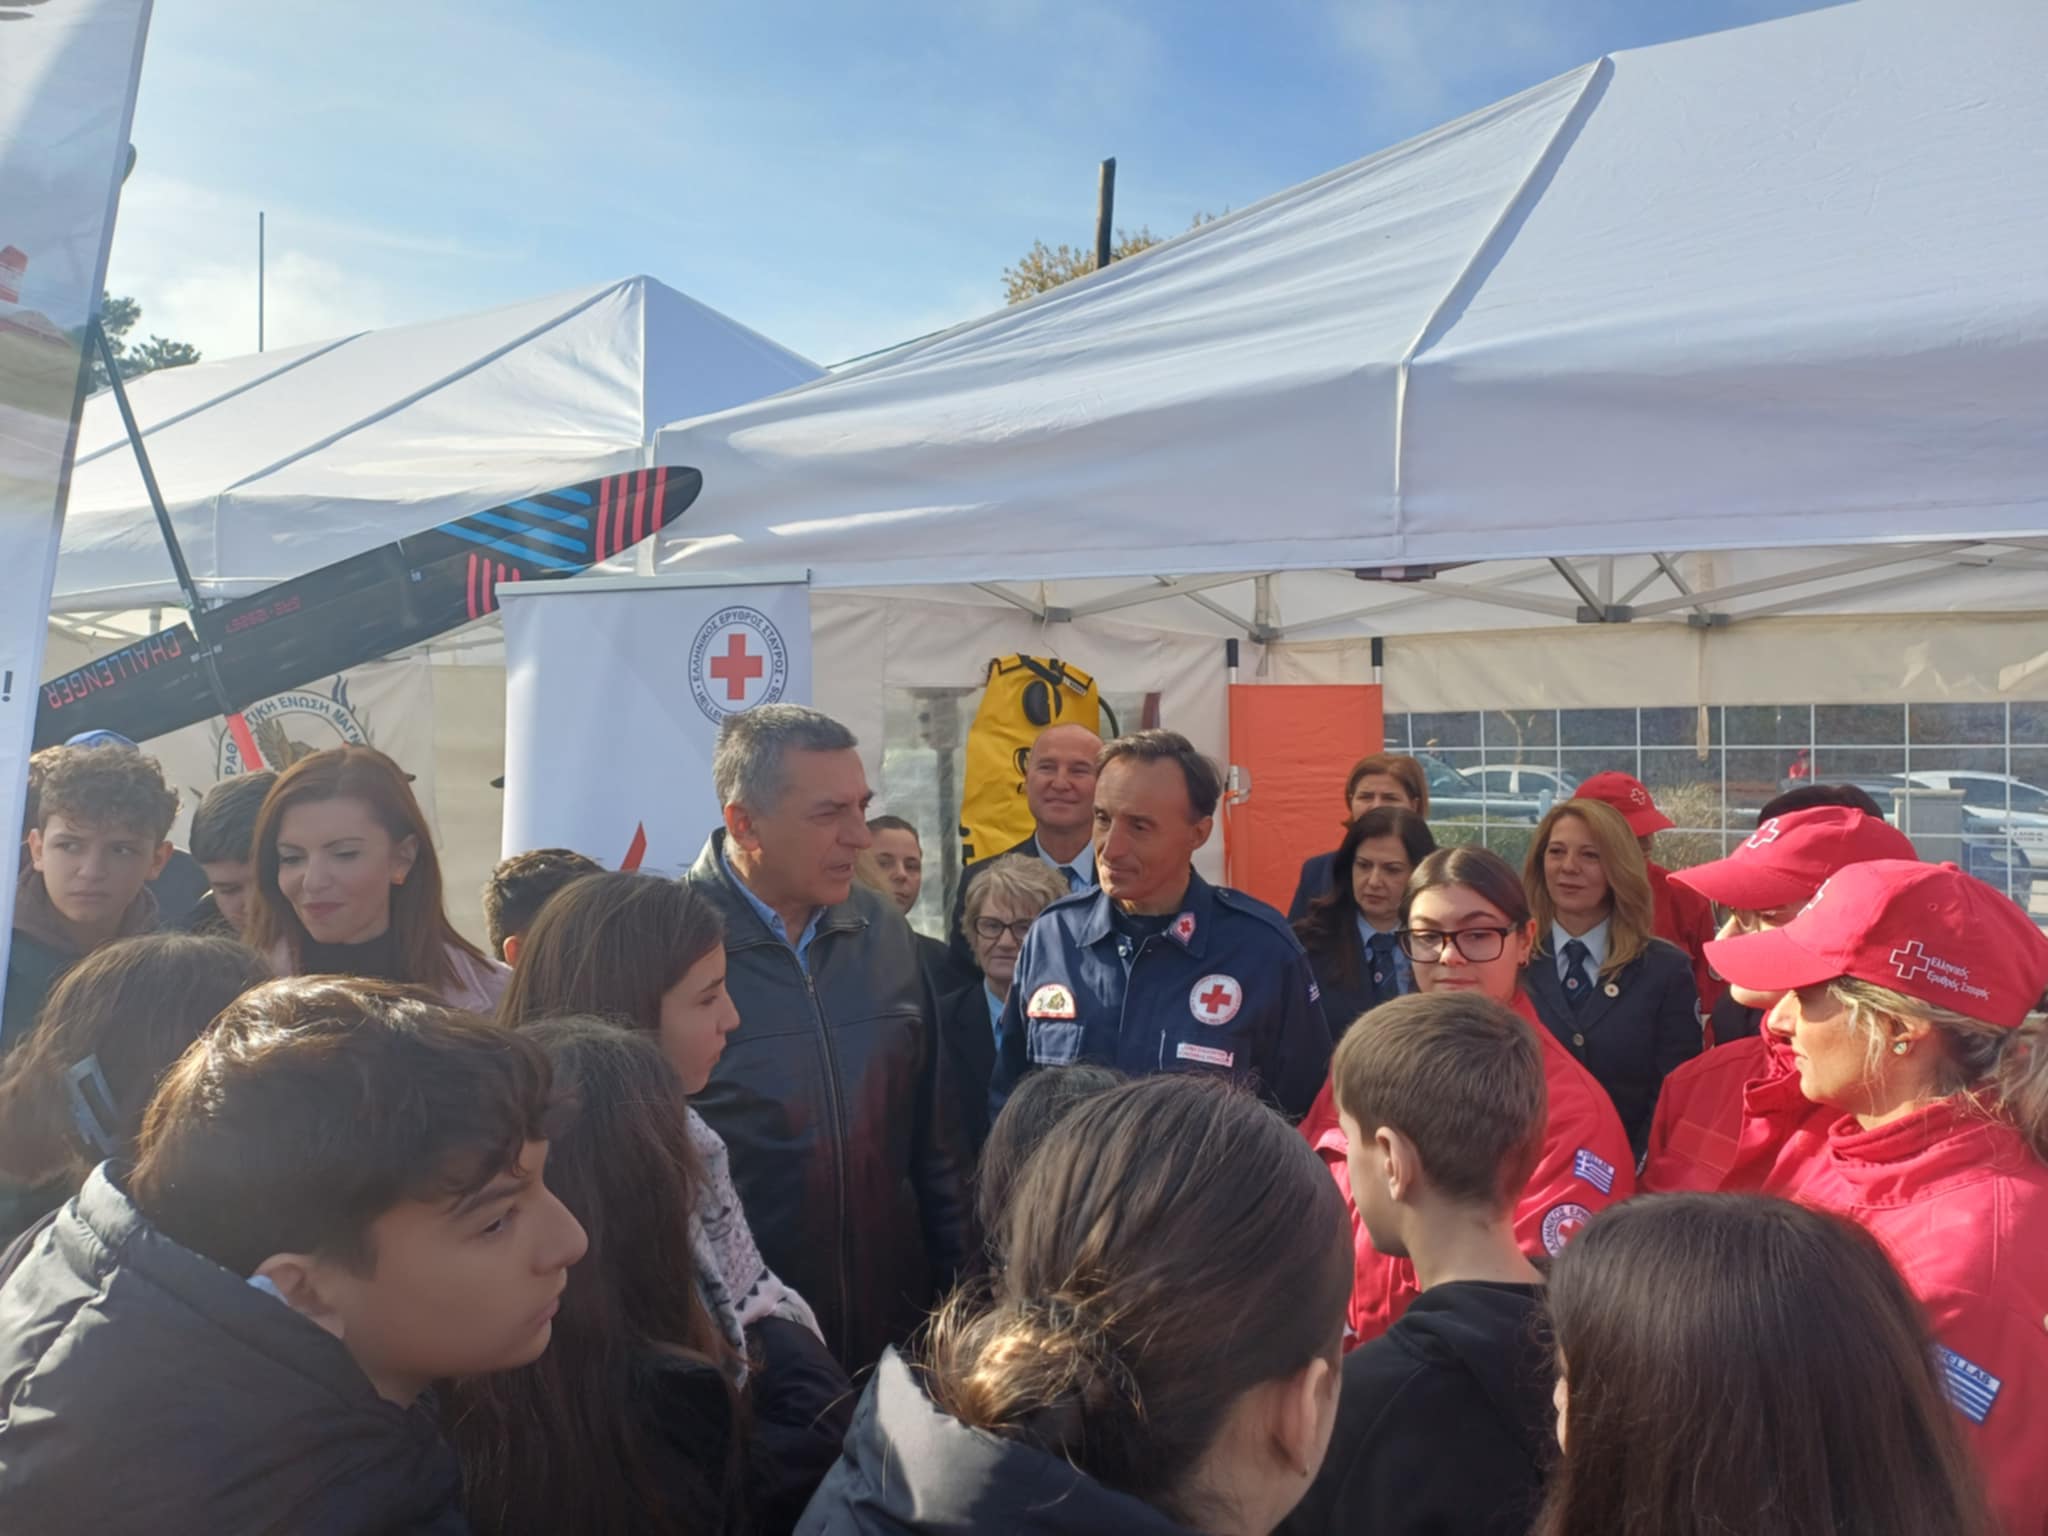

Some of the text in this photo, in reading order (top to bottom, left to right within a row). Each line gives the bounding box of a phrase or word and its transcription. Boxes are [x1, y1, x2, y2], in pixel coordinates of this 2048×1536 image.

[718, 610, 764, 628] ΕΡΥΘΡΟΣ
[44, 631, 183, 710] CHALLENGER
[277, 695, 331, 715] ΕΝΩΣΗ
[332, 708, 364, 747] ΜΑΓΝ
